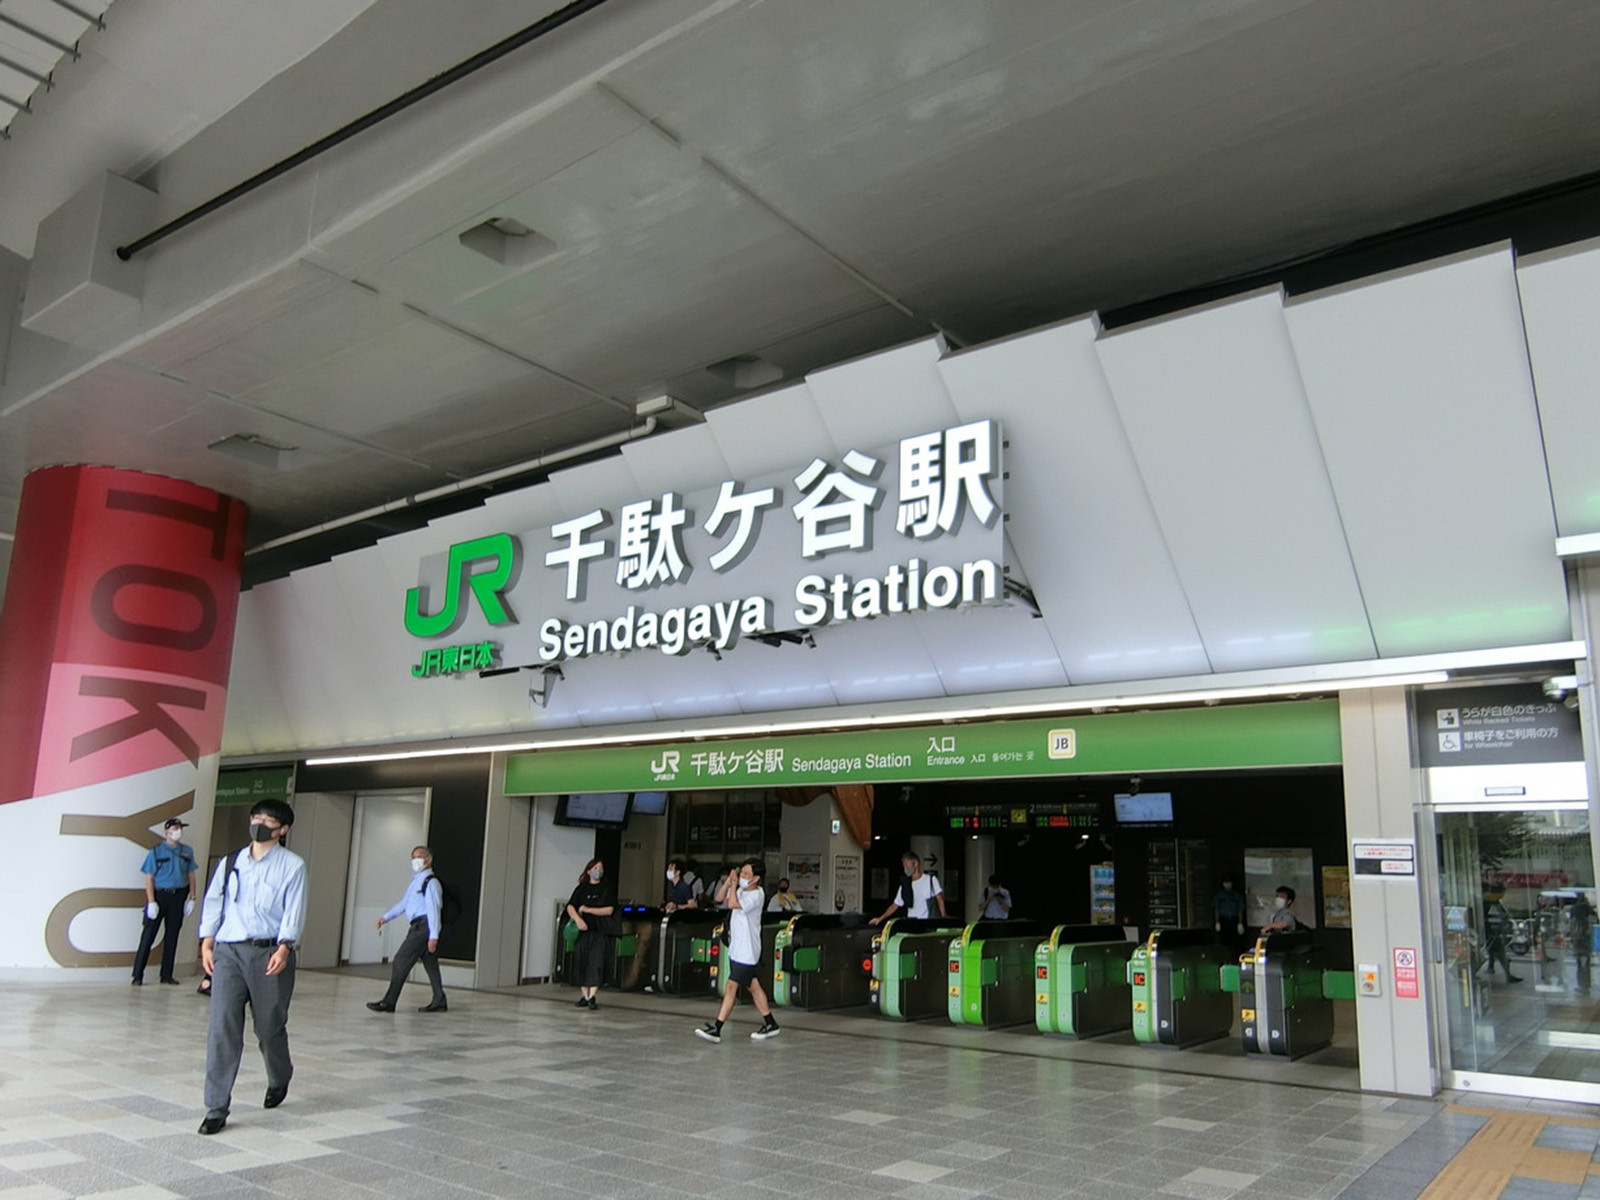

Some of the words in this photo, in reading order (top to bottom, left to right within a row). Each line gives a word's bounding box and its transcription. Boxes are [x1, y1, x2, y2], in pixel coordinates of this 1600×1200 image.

[545, 419, 996, 600] 千駄ケ谷駅
[404, 532, 514, 637] JR
[538, 595, 766, 661] Sendagaya
[793, 558, 996, 626] Station
[411, 640, 494, 677] JR東日本
[45, 489, 232, 967] TOKYO
[926, 736, 956, 754] 入口
[1055, 738, 1069, 750] JB
[651, 751, 680, 773] JR
[690, 748, 784, 776] 千駄ケ谷駅
[791, 757, 862, 774] Sendagaya
[865, 753, 912, 769] Station
[927, 755, 965, 766] Entrance
[1134, 949, 1147, 959] IC
[1134, 974, 1145, 985] IC
